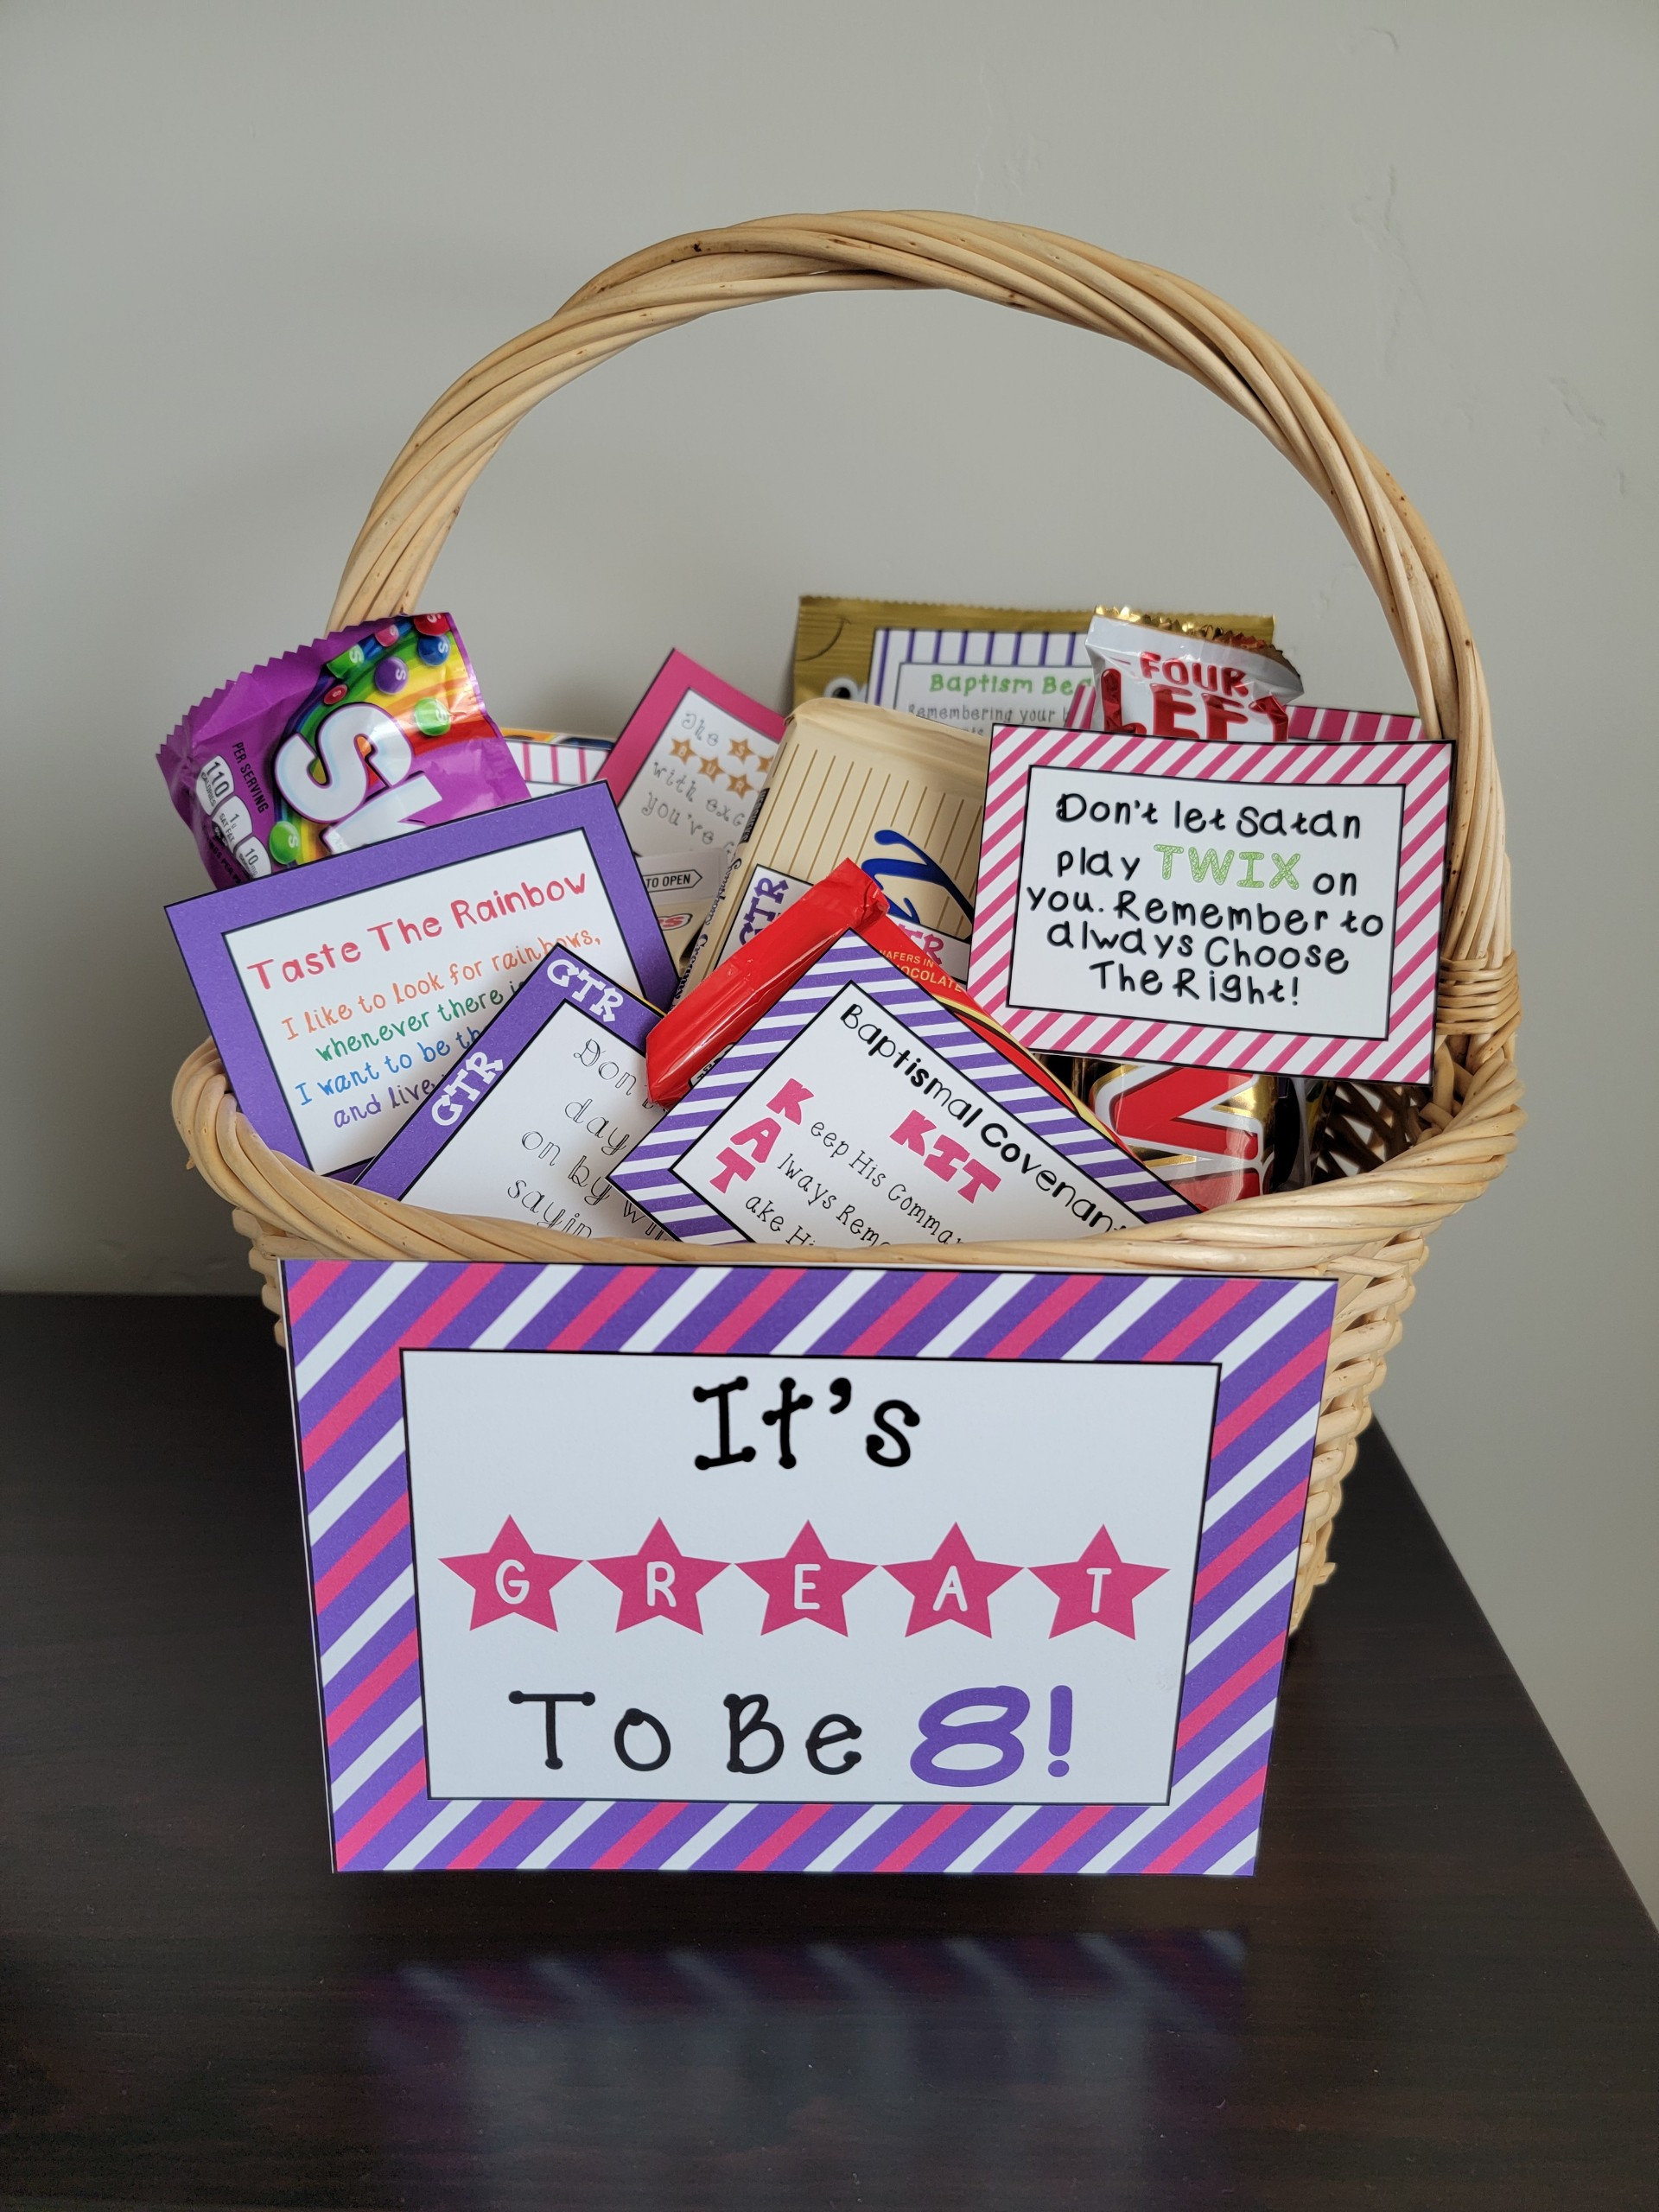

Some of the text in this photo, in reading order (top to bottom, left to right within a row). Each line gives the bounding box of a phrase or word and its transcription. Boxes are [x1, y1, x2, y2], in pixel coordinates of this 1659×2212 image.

[929, 673, 1033, 696] Baptism
[1139, 651, 1249, 697] FOUR
[908, 703, 1013, 724] Remembering
[1020, 708, 1056, 723] your
[207, 761, 230, 798] 110
[232, 741, 270, 814] PER SERVING
[652, 761, 697, 803] with
[640, 791, 715, 845] you've
[1054, 791, 1360, 840] Don't let Satan
[645, 874, 691, 889] TO OPEN
[1056, 843, 1357, 898] play TWIX on
[245, 873, 586, 990] Taste The Rainbow
[1026, 886, 1384, 938] you. Remember to
[923, 958, 934, 969] IN
[1046, 919, 1349, 976] always Choose
[281, 930, 601, 1041] I like to look for rainbows,
[546, 959, 624, 1023] CTR
[897, 965, 962, 993] OCOLATE
[1089, 960, 1300, 1007] The Right!
[315, 1011, 430, 1062] whenever
[437, 989, 504, 1023] there
[295, 1082, 313, 1106] I
[317, 1062, 380, 1096] want
[384, 1053, 413, 1074] to
[416, 1039, 451, 1063] be
[431, 1051, 504, 1126] CTR
[840, 1003, 983, 1128] Baptismal
[334, 1079, 435, 1128] and live
[564, 1098, 631, 1156] day
[521, 1130, 613, 1206] on by
[848, 1149, 887, 1188] His
[888, 1109, 1002, 1205] KIT
[693, 1376, 922, 1471] It's
[507, 1685, 1075, 1789] To Be 8!
